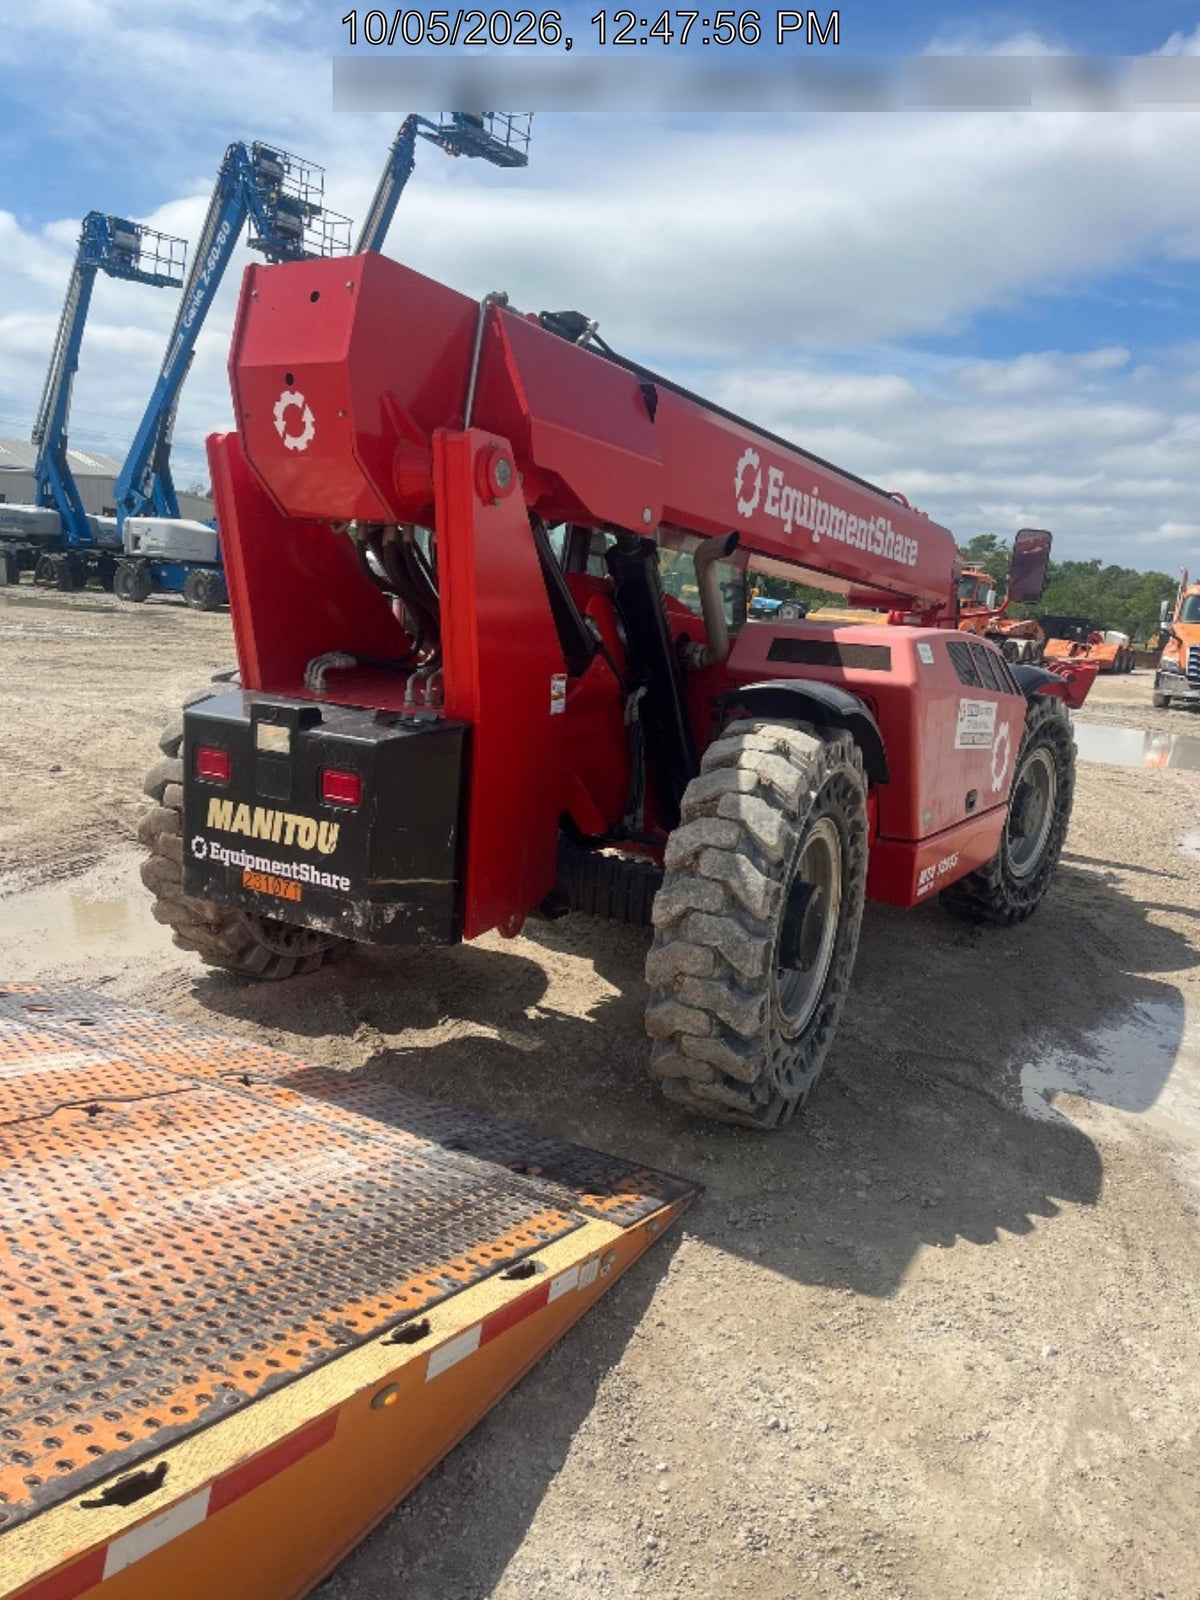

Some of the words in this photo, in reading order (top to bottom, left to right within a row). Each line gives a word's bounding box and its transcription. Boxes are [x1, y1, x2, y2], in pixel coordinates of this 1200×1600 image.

[764, 465, 919, 566] EquipmentShare
[206, 797, 341, 854] MANITOU
[209, 841, 350, 892] EquipmentShare
